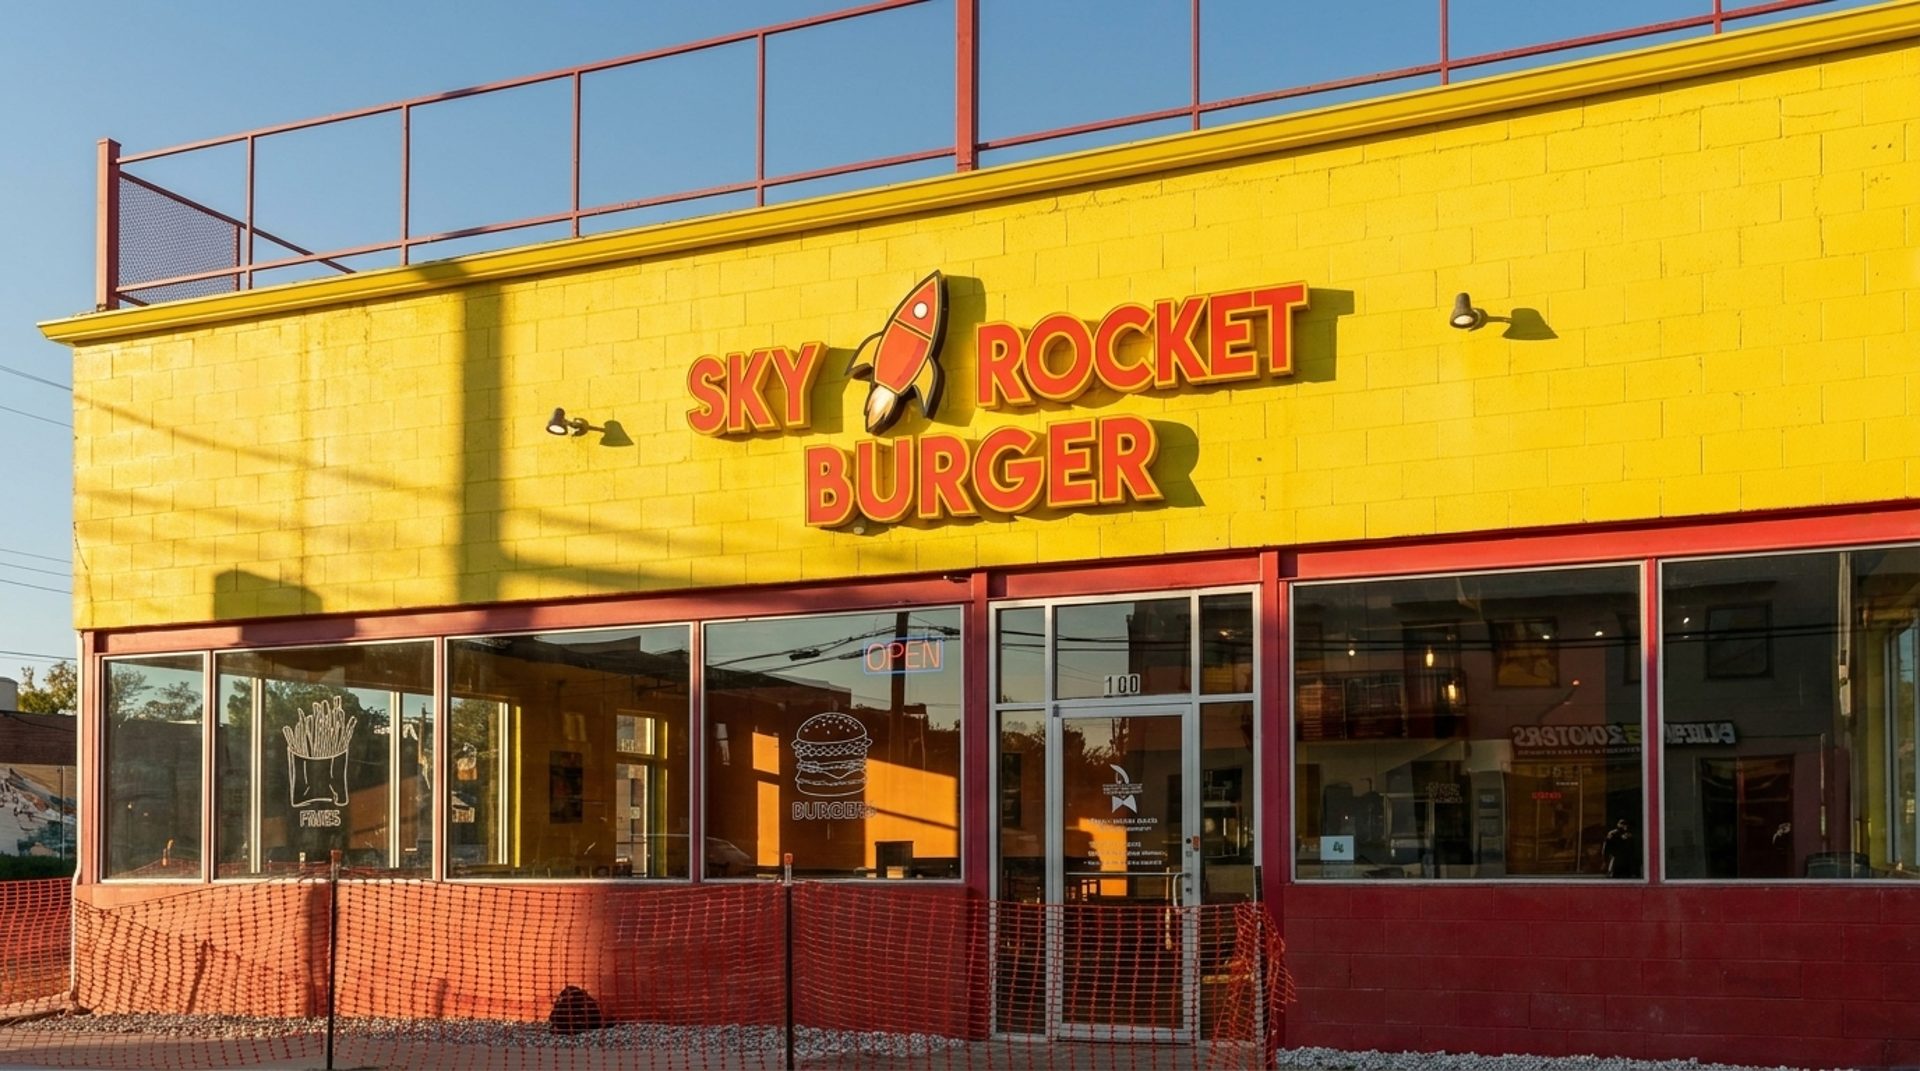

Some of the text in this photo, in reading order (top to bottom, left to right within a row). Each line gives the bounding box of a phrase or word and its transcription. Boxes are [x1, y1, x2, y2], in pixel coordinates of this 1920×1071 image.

[686, 281, 1309, 437] SKY ROCKET
[804, 414, 1163, 528] BURGER
[866, 639, 941, 671] OPEN
[1106, 674, 1139, 695] 100
